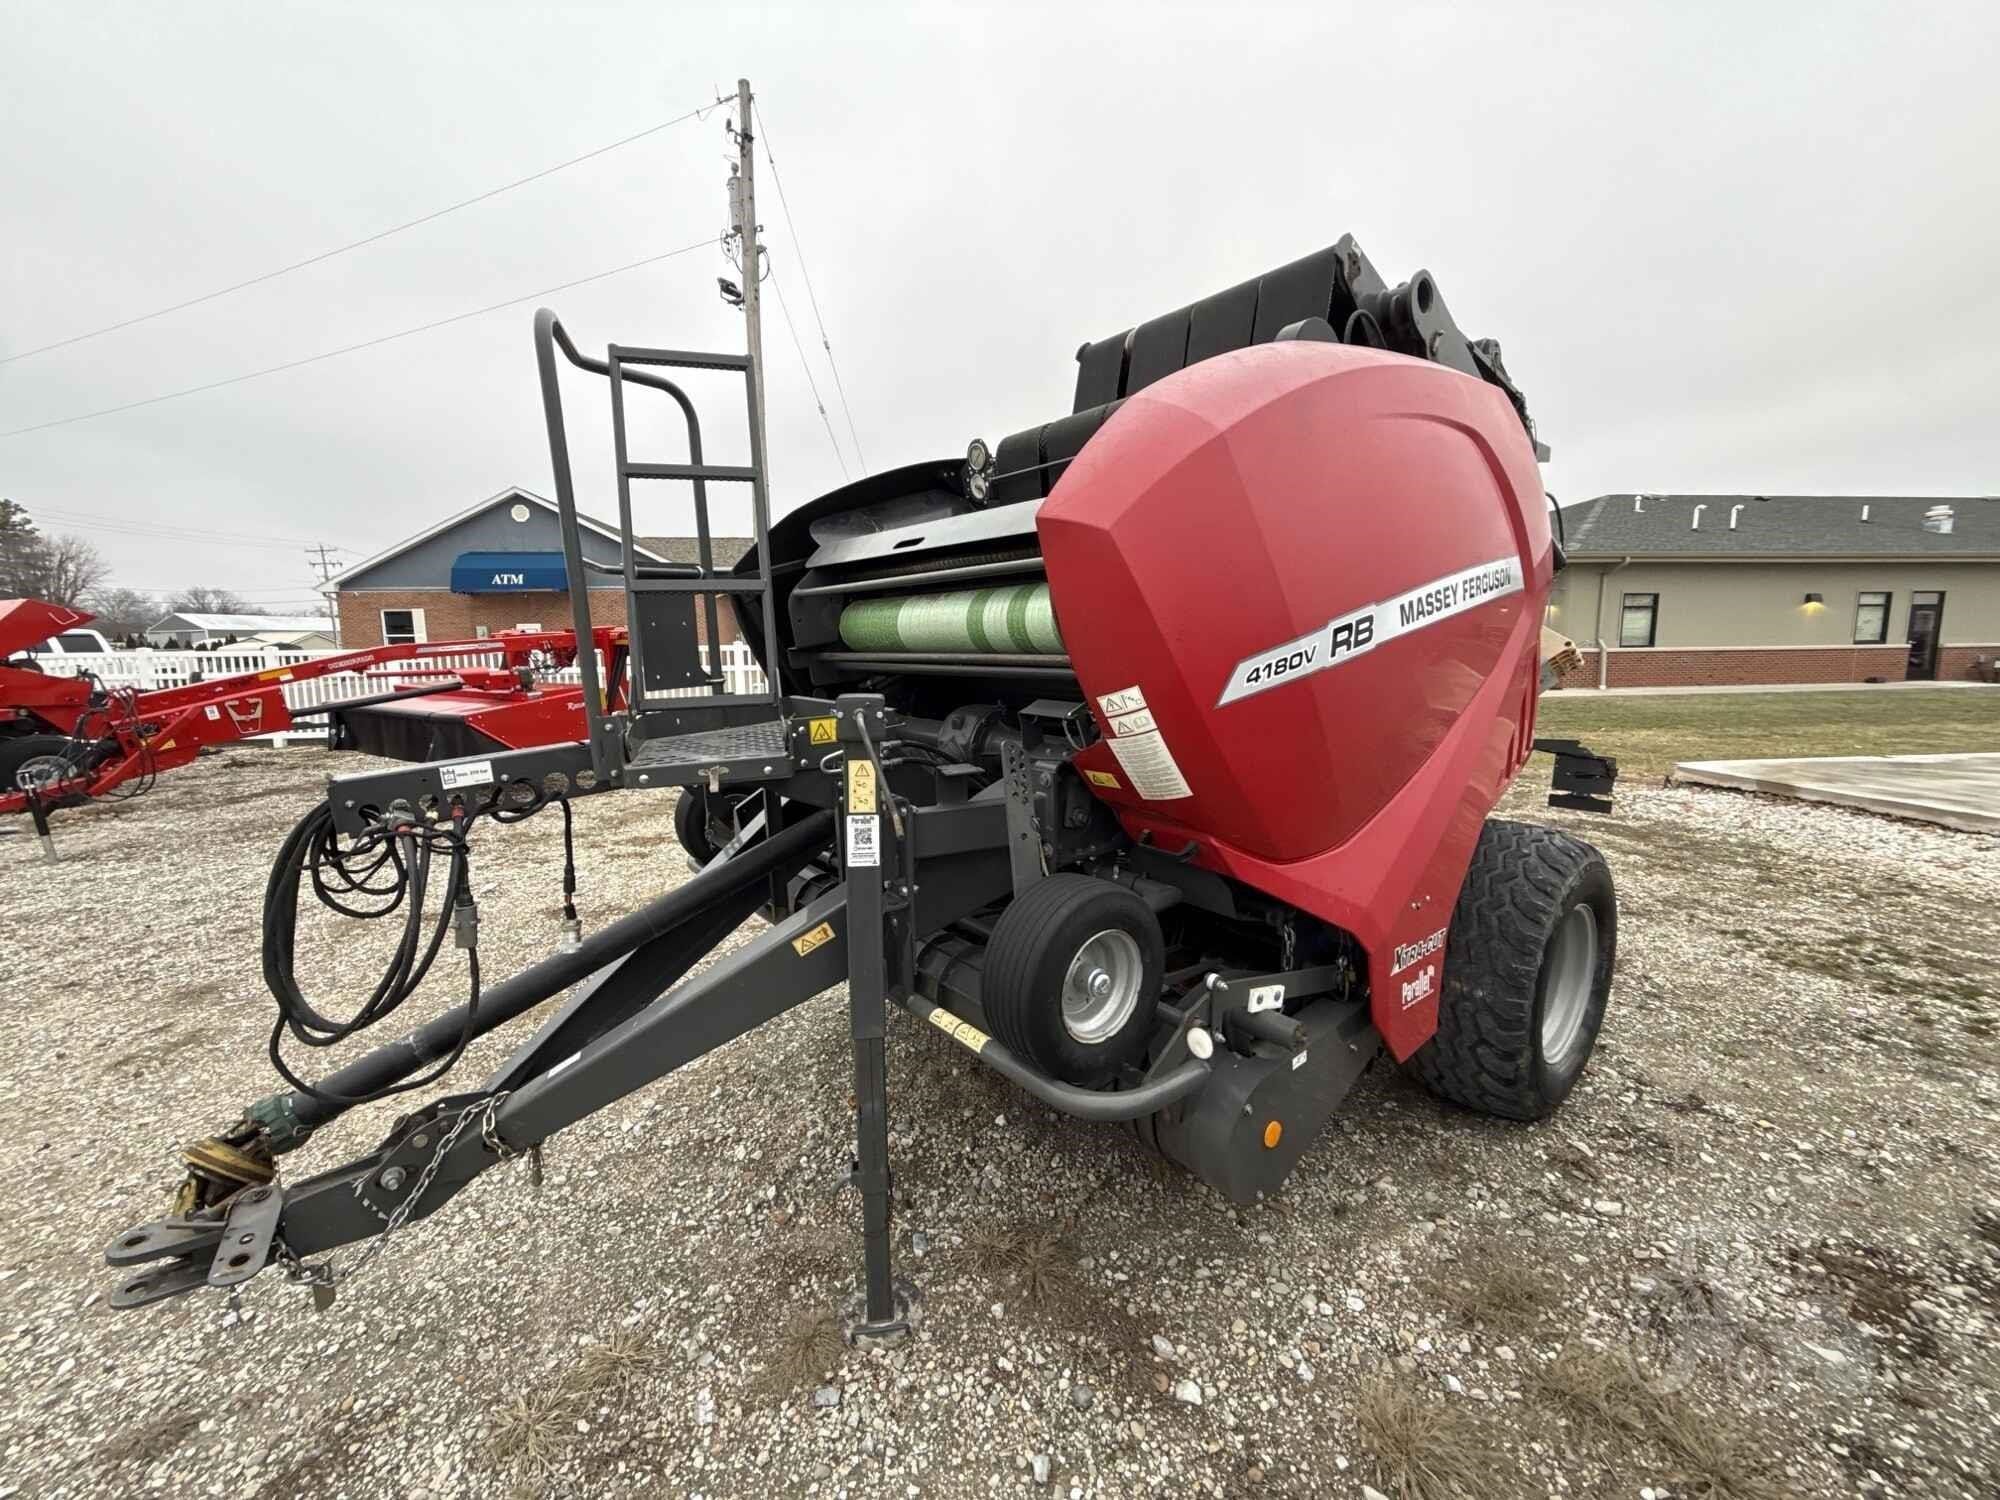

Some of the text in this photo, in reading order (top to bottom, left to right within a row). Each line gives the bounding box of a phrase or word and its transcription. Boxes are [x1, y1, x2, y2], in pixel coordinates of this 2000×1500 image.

[491, 574, 524, 585] ATM
[1246, 567, 1511, 684] 4180V RB MASSEY FERGUSON
